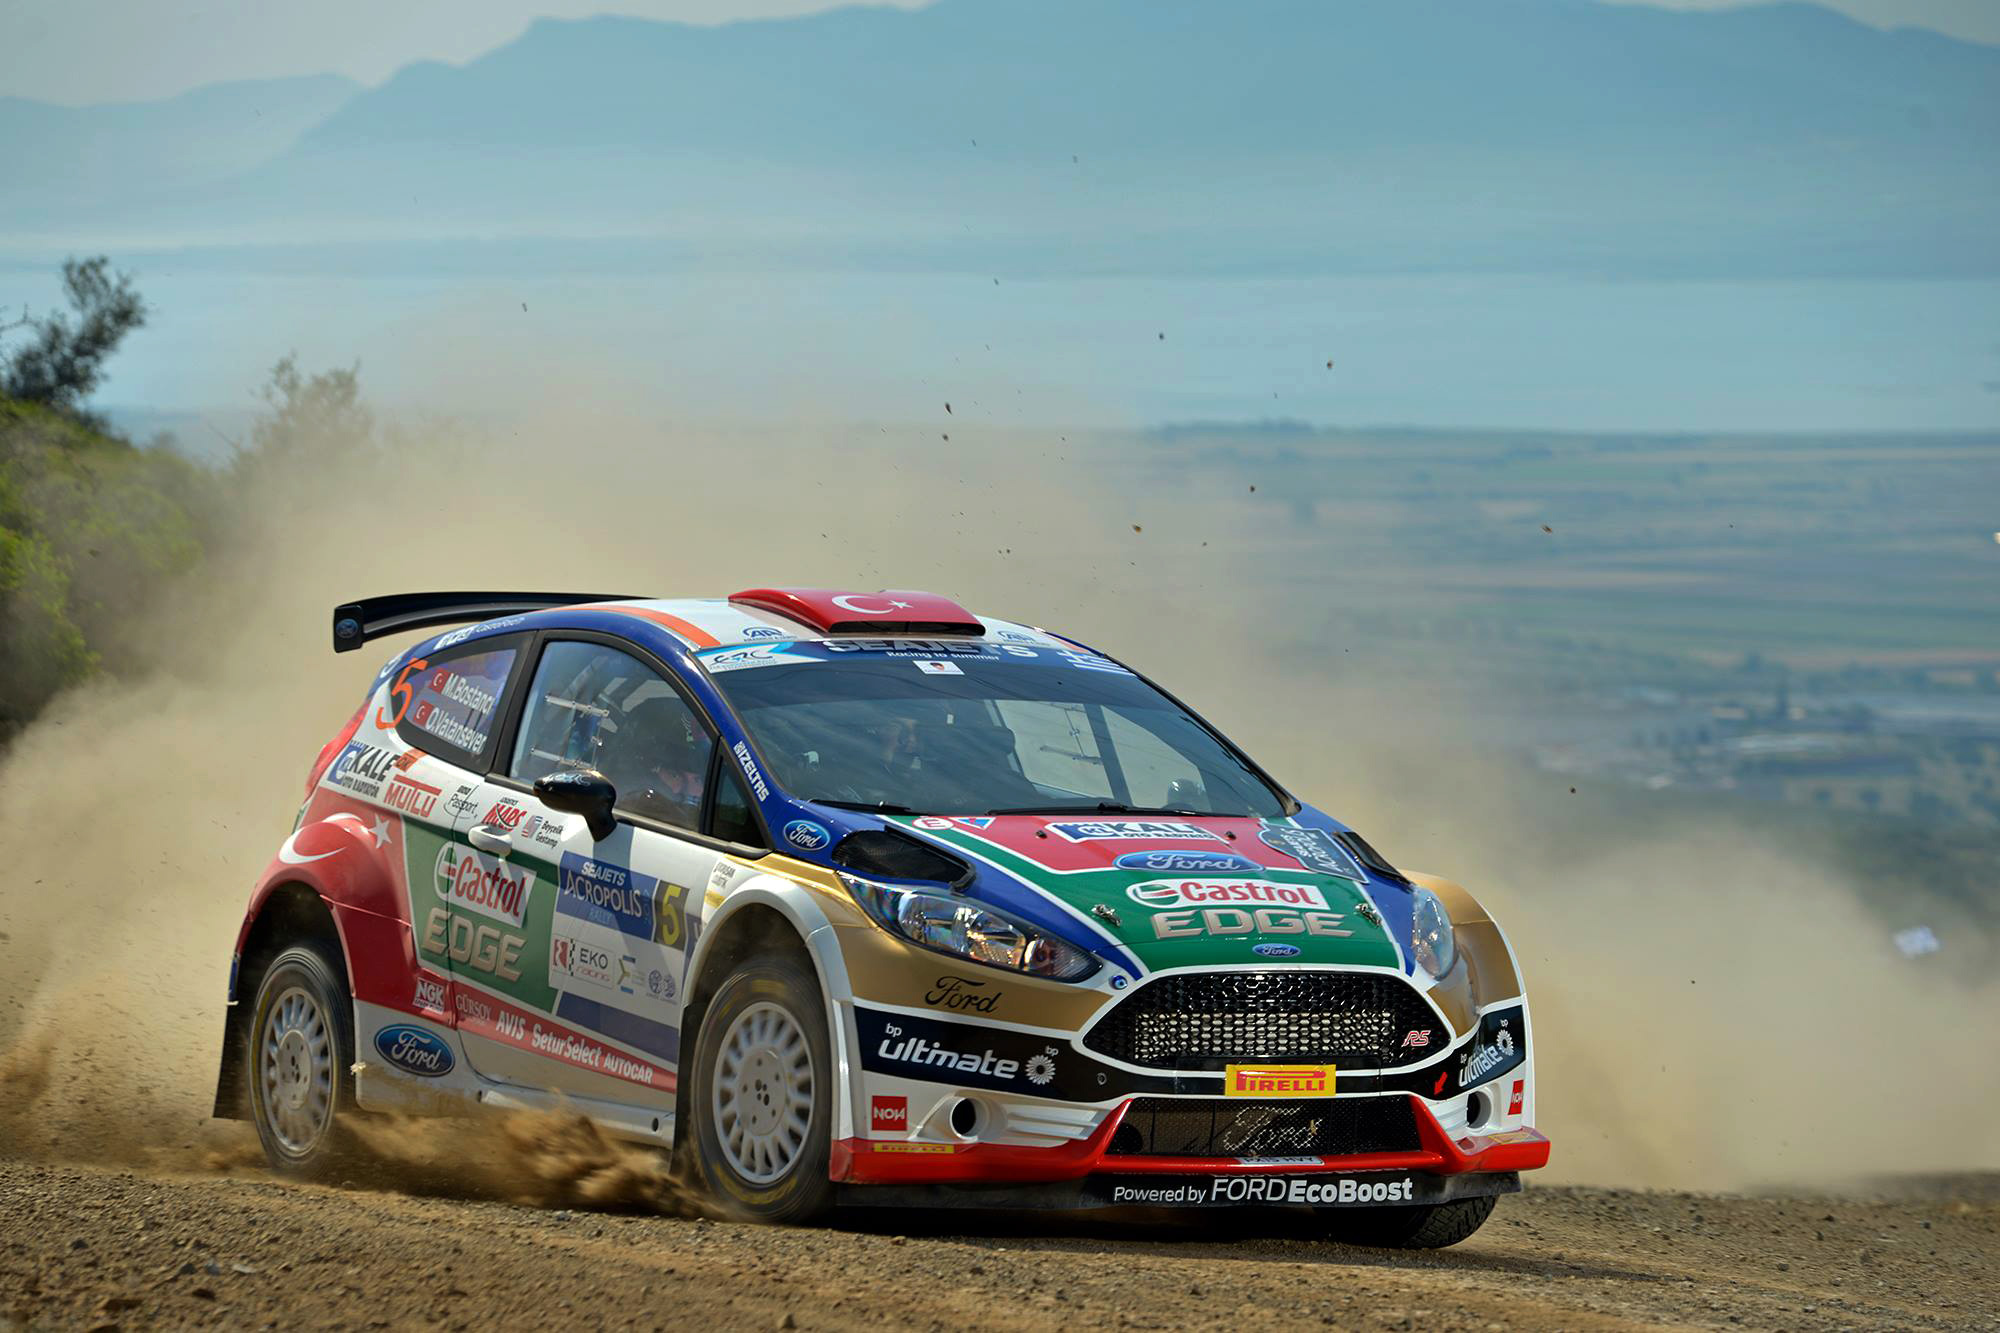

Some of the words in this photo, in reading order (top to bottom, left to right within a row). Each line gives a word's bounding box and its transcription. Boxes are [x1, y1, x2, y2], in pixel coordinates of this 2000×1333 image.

[887, 651, 933, 660] Racing
[951, 653, 1000, 662] summer
[375, 657, 429, 731] 5
[348, 744, 401, 783] KALE
[383, 774, 442, 818] MUTLU
[788, 823, 822, 849] Ford
[580, 861, 628, 887] SEAJETS
[1146, 852, 1242, 871] Ford
[454, 855, 528, 917] Castrol
[562, 869, 643, 919] ACROPOLIS
[1179, 881, 1319, 905] Castrol
[662, 884, 682, 945] 5
[1151, 907, 1356, 939] EDGE
[420, 906, 528, 983] EDGE
[579, 947, 609, 970] EKO
[1262, 943, 1295, 956] Ford
[414, 981, 444, 1007] NGK
[924, 975, 1003, 1014] Ford
[884, 1022, 903, 1038] bp
[391, 1029, 442, 1071] Ford
[495, 1010, 527, 1041] AVIS
[603, 1052, 655, 1085] AUTOCAR
[877, 1037, 1021, 1080] ultimate
[1045, 1044, 1060, 1057] bp
[1235, 1069, 1327, 1091] PIRELLI
[1458, 1042, 1504, 1087] ultimate
[1114, 1186, 1188, 1202] Powered
[1188, 1186, 1207, 1204] by
